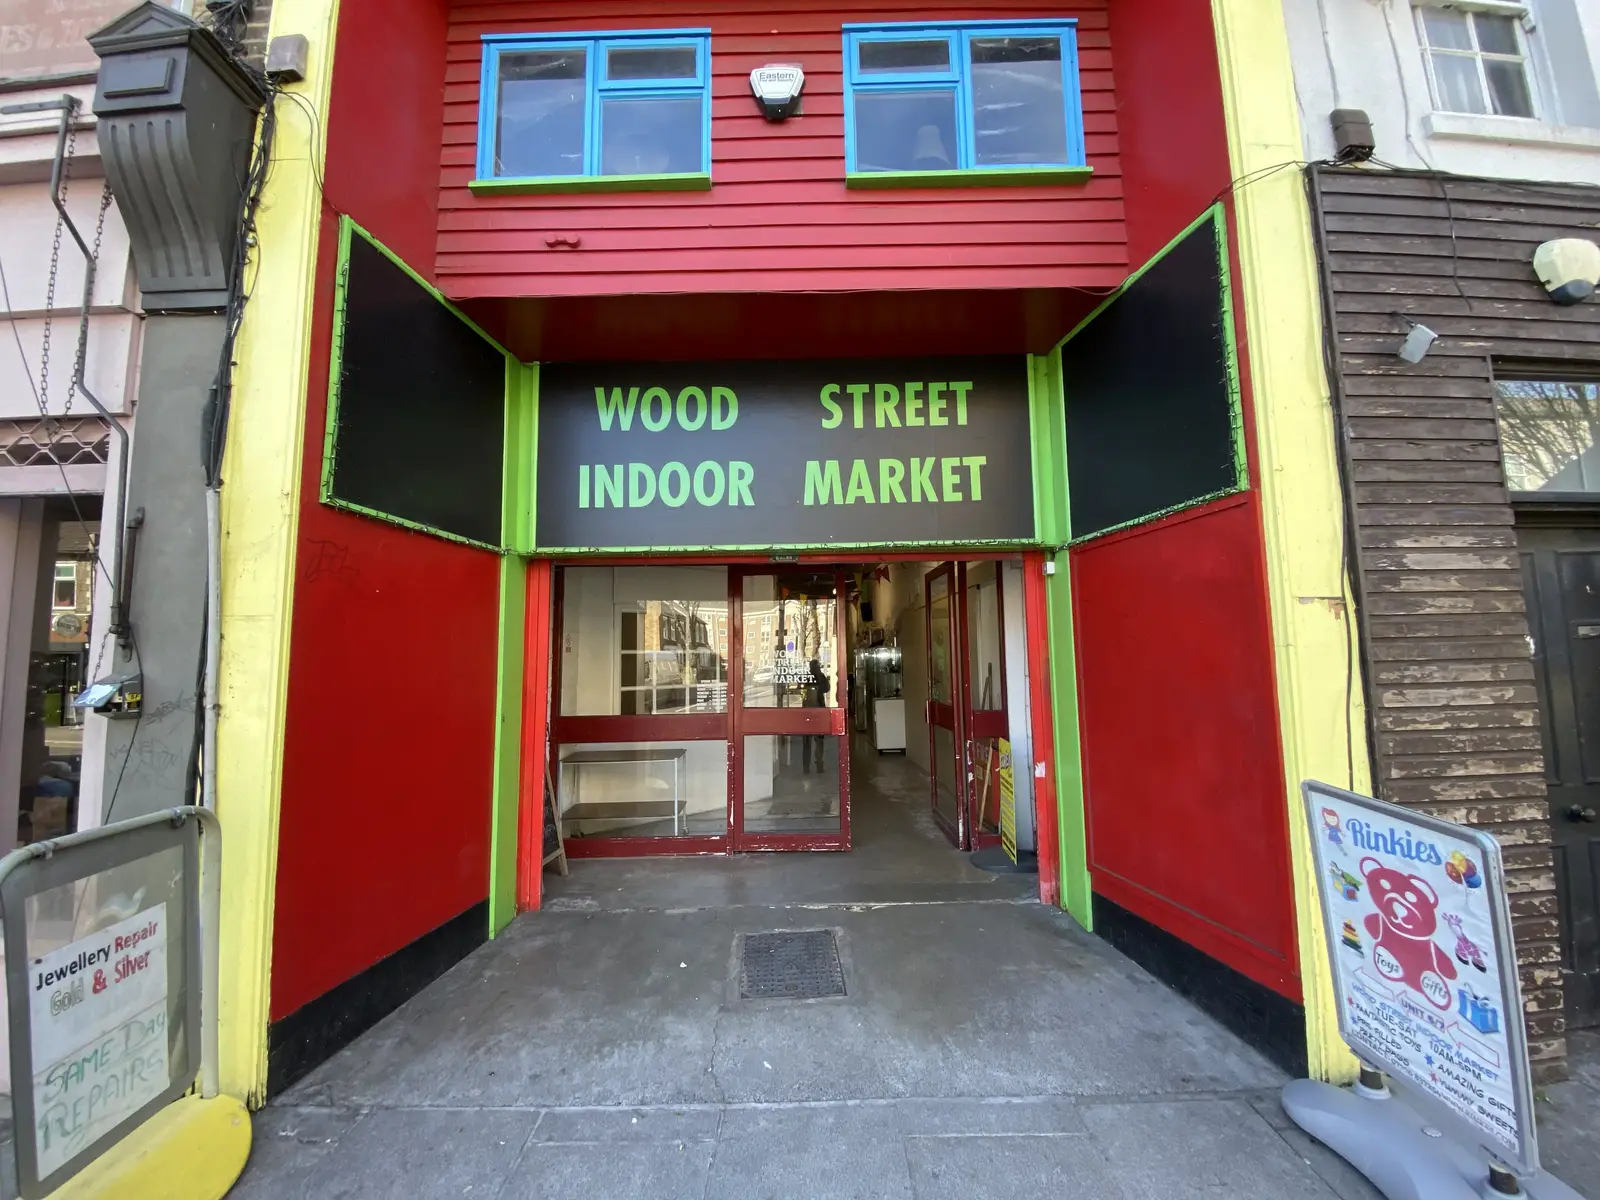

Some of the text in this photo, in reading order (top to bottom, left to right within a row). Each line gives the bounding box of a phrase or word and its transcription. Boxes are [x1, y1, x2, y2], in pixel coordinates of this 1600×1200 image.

[594, 381, 973, 432] WOOD STREET
[579, 456, 988, 509] INDOOR MARKET
[1346, 818, 1442, 866] Rinkies
[36, 921, 158, 991] Jewellery Repair
[1376, 951, 1399, 973] Toys
[50, 951, 151, 1017] Gold & Silver
[1401, 997, 1425, 1019] UNIT
[1422, 976, 1448, 999] Gifts
[1376, 1006, 1482, 1081] TUE-SAT 10AM-5PM
[1399, 1031, 1422, 1053] TOYS
[1454, 1050, 1499, 1081] MARKET
[43, 1037, 114, 1103] SAME
[1437, 1064, 1516, 1120] AMAZING GIFTS
[37, 1049, 163, 1153] REPAIRS
[1439, 1077, 1519, 1139] YUMMY SWEETS
